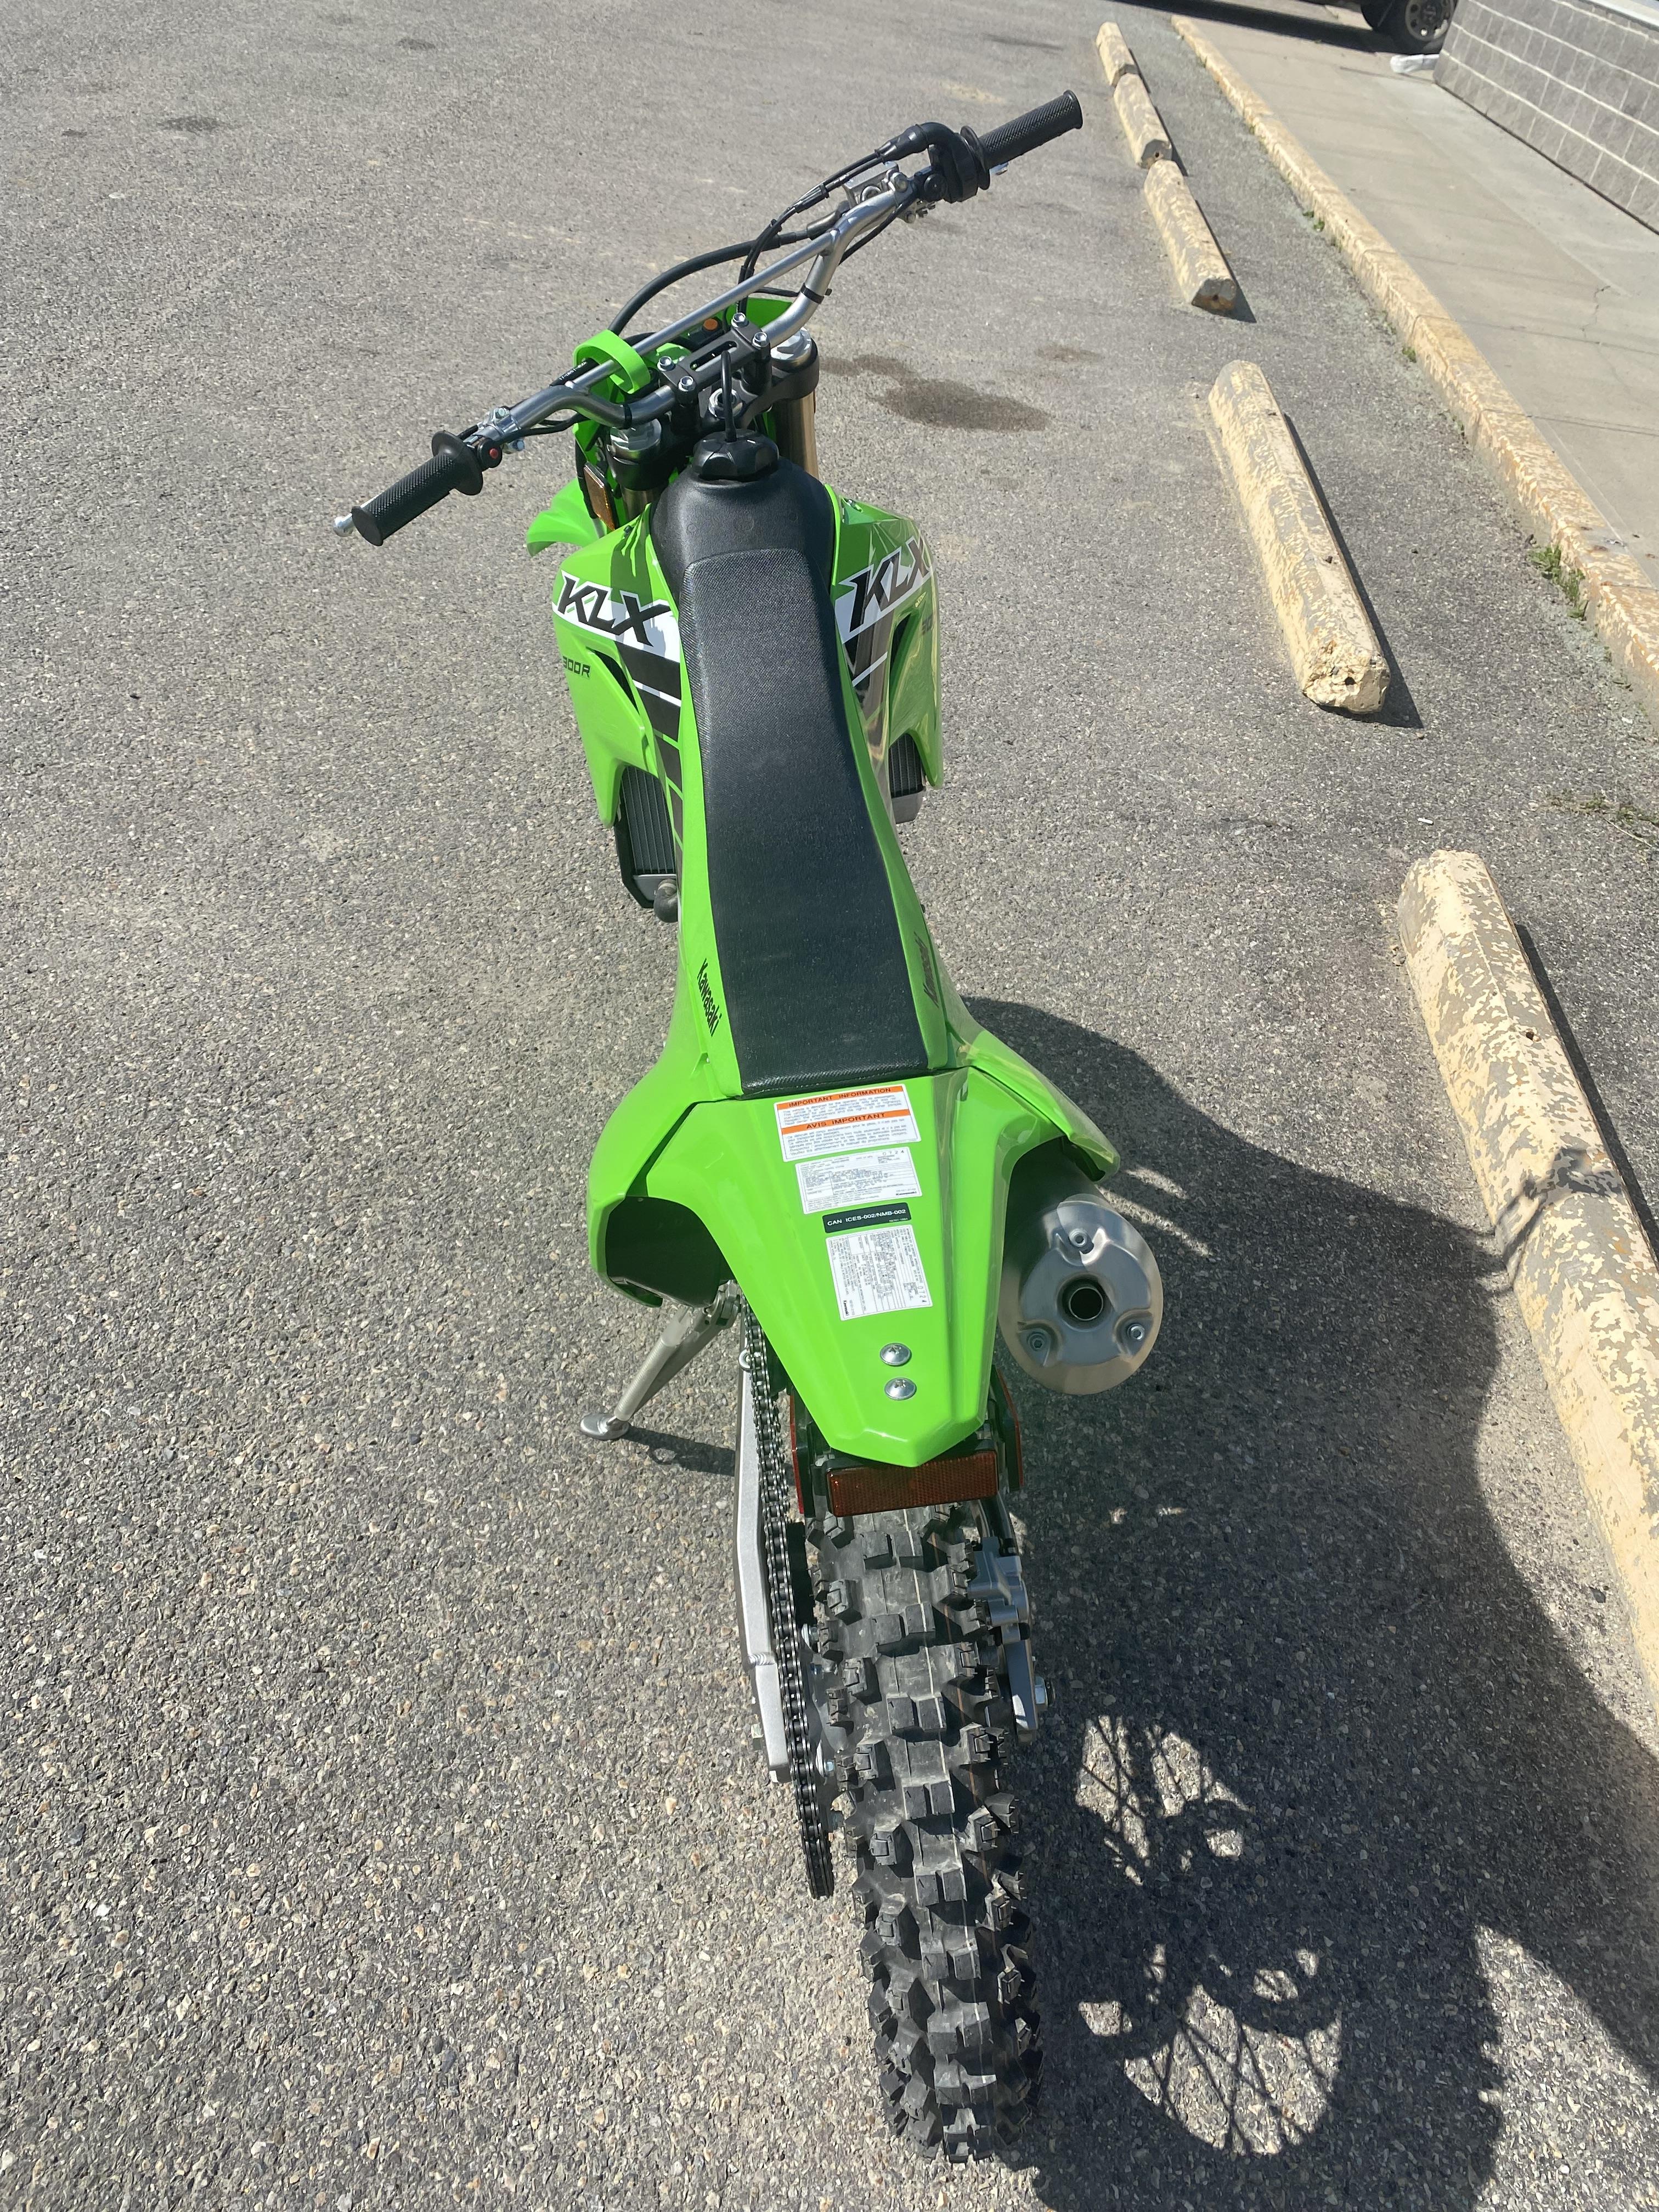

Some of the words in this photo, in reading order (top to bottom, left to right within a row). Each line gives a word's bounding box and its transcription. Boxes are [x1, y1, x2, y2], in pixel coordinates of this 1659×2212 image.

[849, 537, 930, 633] KLX
[557, 575, 672, 647] KLX
[562, 656, 591, 678] 300R
[697, 957, 722, 1037] Kawasaki
[789, 1096, 833, 1107] IMPORTANT
[838, 1088, 891, 1099] INFORMATION
[806, 1121, 827, 1130] AVIS
[832, 1113, 885, 1125] IMPORTANT
[845, 1209, 906, 1222] ICES-002/NMB-002
